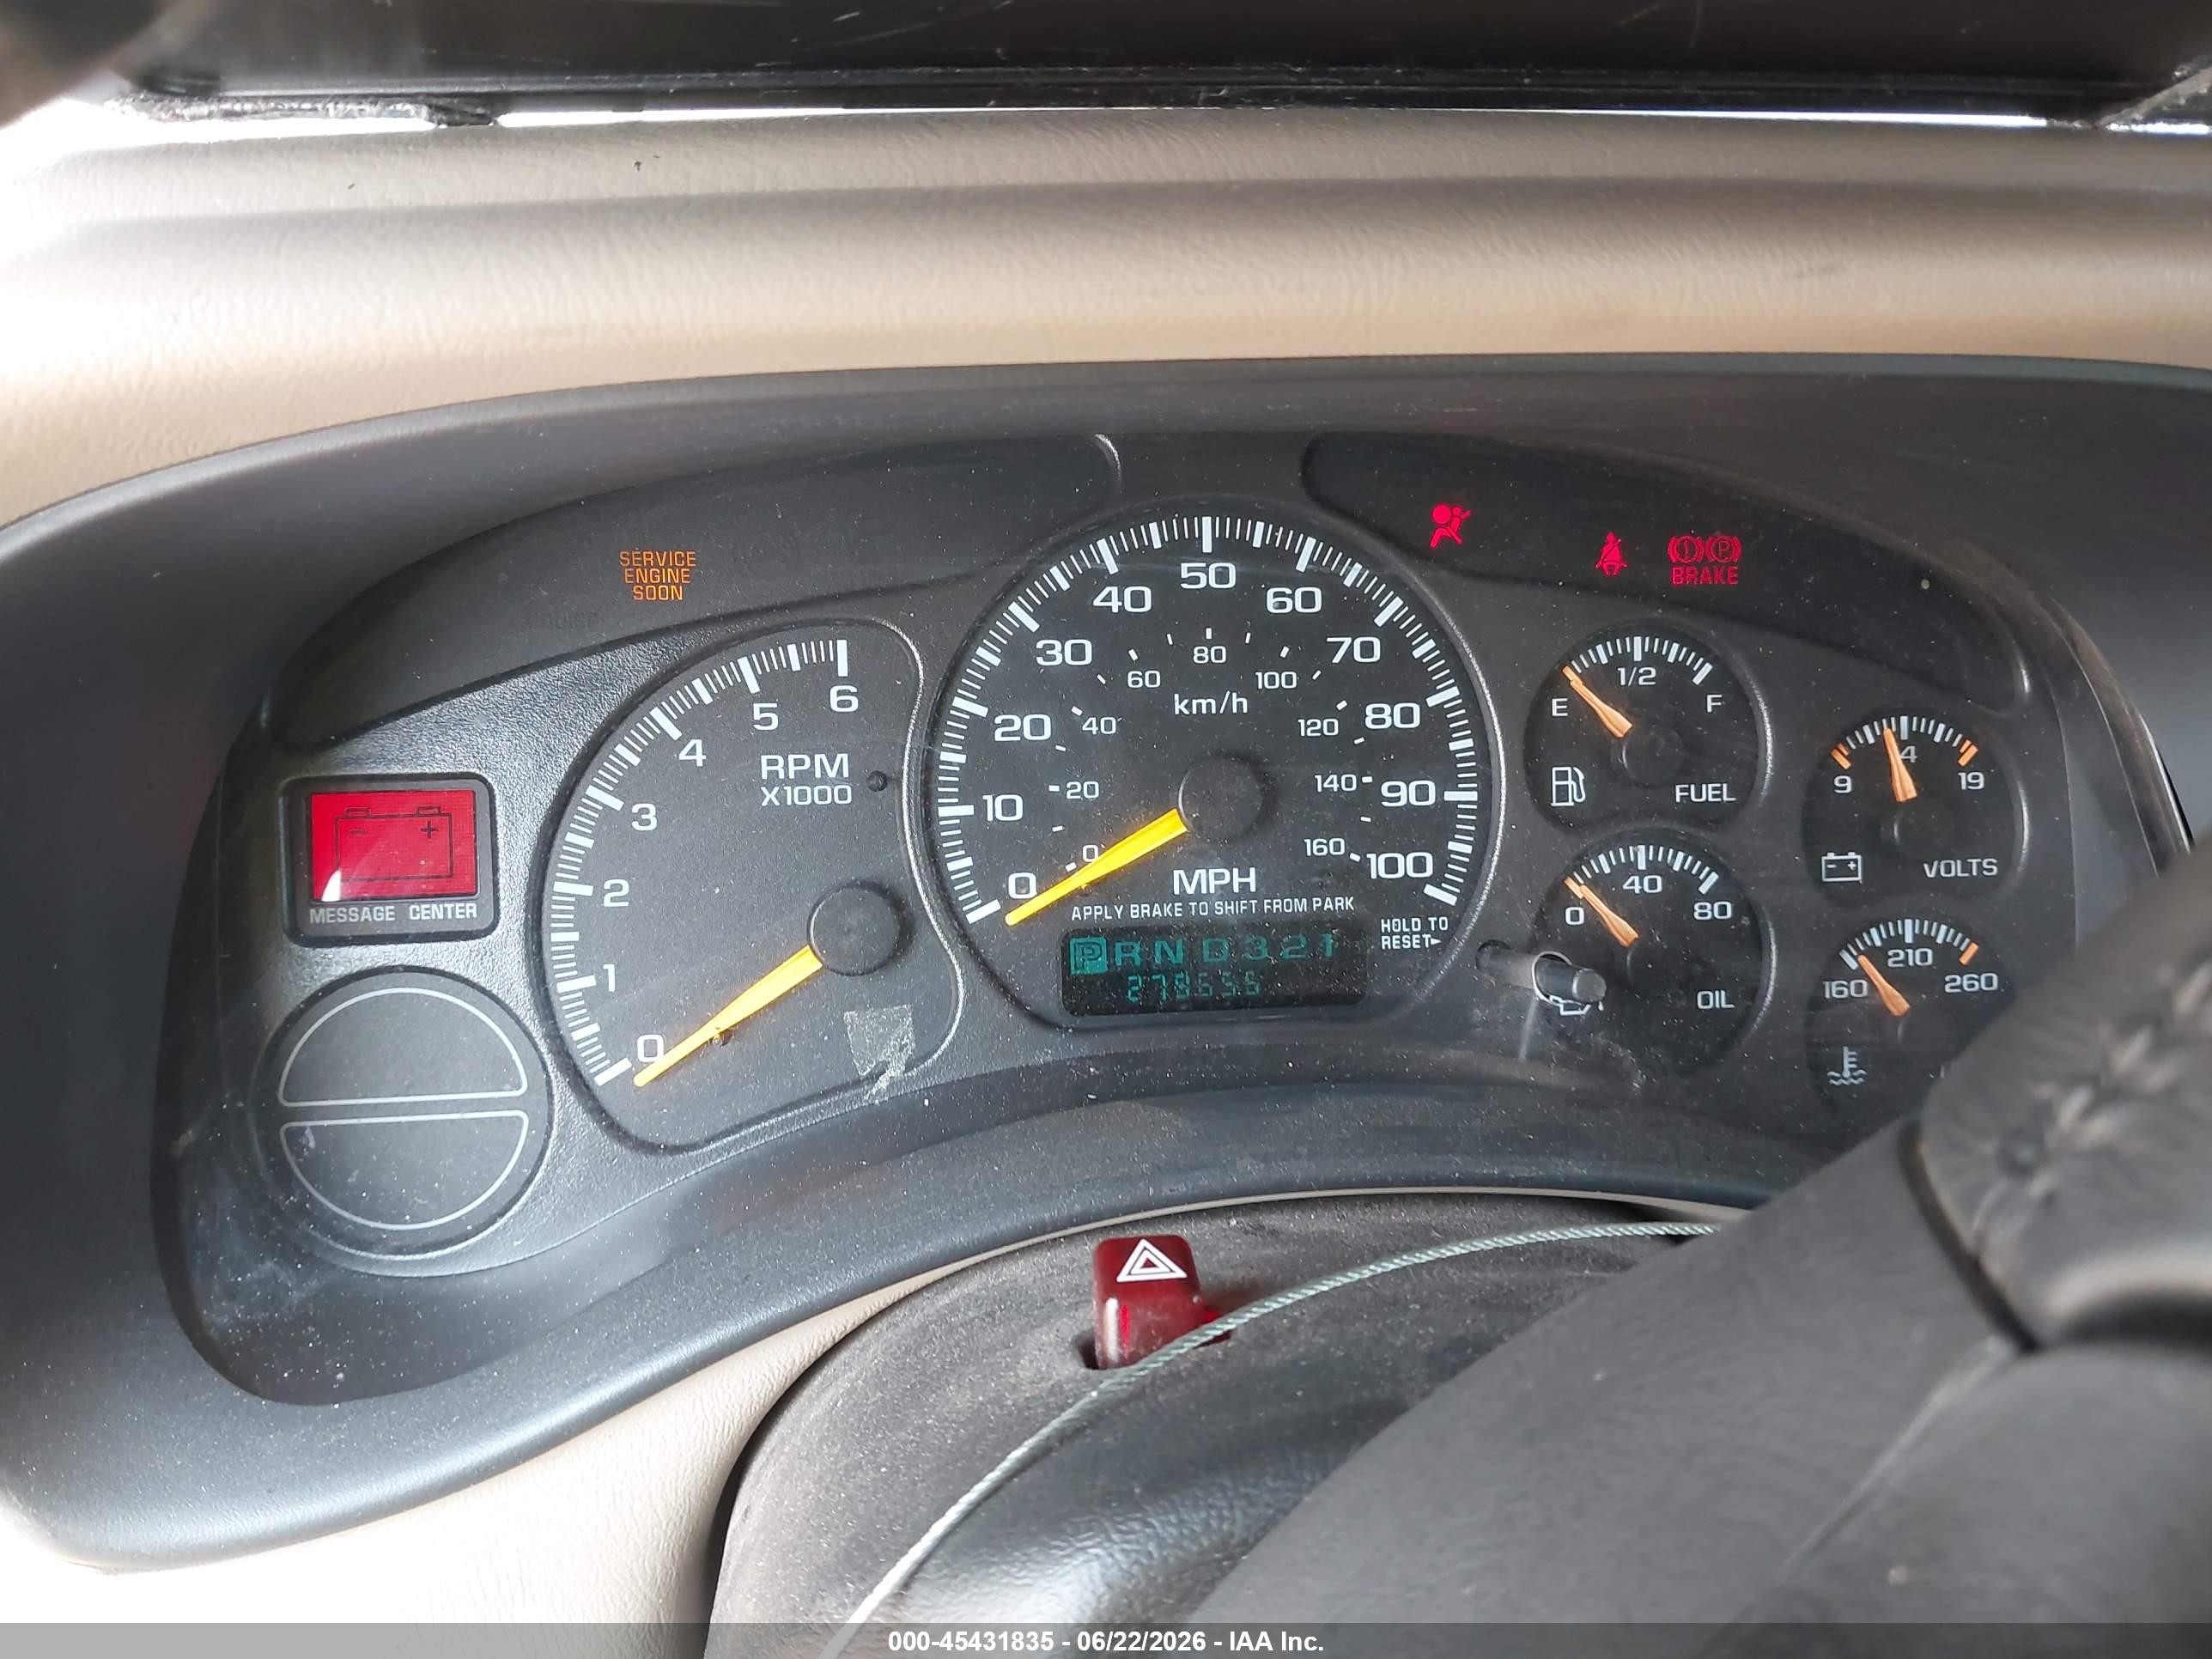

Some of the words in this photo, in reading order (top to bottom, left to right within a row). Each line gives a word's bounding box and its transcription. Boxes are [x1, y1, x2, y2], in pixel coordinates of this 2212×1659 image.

[619, 550, 696, 568] SERVICE
[624, 568, 690, 584] ENGINE
[1180, 562, 1237, 589] 50
[1671, 566, 1738, 585] BRAKE
[633, 585, 684, 601] SOON
[1092, 586, 1152, 613] 40
[1267, 586, 1322, 614] 60
[1036, 639, 1092, 666] 30
[1193, 646, 1227, 664] 80
[1326, 636, 1381, 664] 70
[1127, 670, 1161, 689] 60
[1255, 671, 1297, 690] 100
[1617, 666, 1656, 686] 1/2
[830, 685, 859, 713] 6
[1174, 690, 1248, 715] km/h
[1552, 697, 1568, 717] E
[1706, 694, 1723, 713] F
[752, 702, 779, 731] 5
[1082, 716, 1116, 735] 40
[1364, 702, 1420, 730] 80
[994, 714, 1052, 742] 20
[1297, 718, 1339, 737] 120
[678, 739, 707, 767] 4
[1899, 745, 1917, 763] 4
[760, 753, 849, 780] RPM
[1066, 781, 1100, 799] 20
[1314, 774, 1356, 793] 140
[1833, 775, 1852, 793] 9
[1958, 771, 1984, 790] 19
[760, 784, 853, 806] X1000
[1381, 780, 1436, 807] 90
[1675, 783, 1736, 803] FUEL
[631, 803, 658, 831] 3
[982, 794, 1024, 822] 10
[1082, 844, 1099, 862] 0
[1304, 837, 1346, 856] 160
[1366, 852, 1433, 879] 100
[1923, 858, 1998, 878] VOLTS
[1008, 872, 1037, 899] 0
[1173, 866, 1256, 896] MPH
[1622, 875, 1662, 894] 40
[602, 878, 629, 908] 2
[309, 905, 396, 923] MESSAGE
[409, 902, 477, 921] CENTER
[1071, 904, 1124, 921] APPLY
[1130, 902, 1182, 919] BRAKE
[1188, 901, 1209, 916] TO
[1214, 899, 1258, 915] SHIFT
[1263, 897, 1307, 914] FROM
[1312, 896, 1354, 913] PARK
[1565, 906, 1585, 926] 0
[1693, 901, 1732, 921] 80
[1381, 917, 1421, 933] HOLD
[1427, 916, 1449, 932] TO
[1381, 933, 1430, 950] RESET
[1072, 939, 1106, 973] P
[1114, 942, 1141, 967] R
[1153, 940, 1183, 964] N
[1202, 938, 1229, 963] D
[1245, 934, 1268, 961] 3
[1279, 934, 1307, 961] 2
[1887, 947, 1933, 968] 210
[602, 963, 616, 993] 1
[1944, 972, 1998, 993] 260
[1697, 989, 1735, 1010] OIL
[1825, 979, 1869, 999] 160
[636, 1034, 665, 1063] 0
